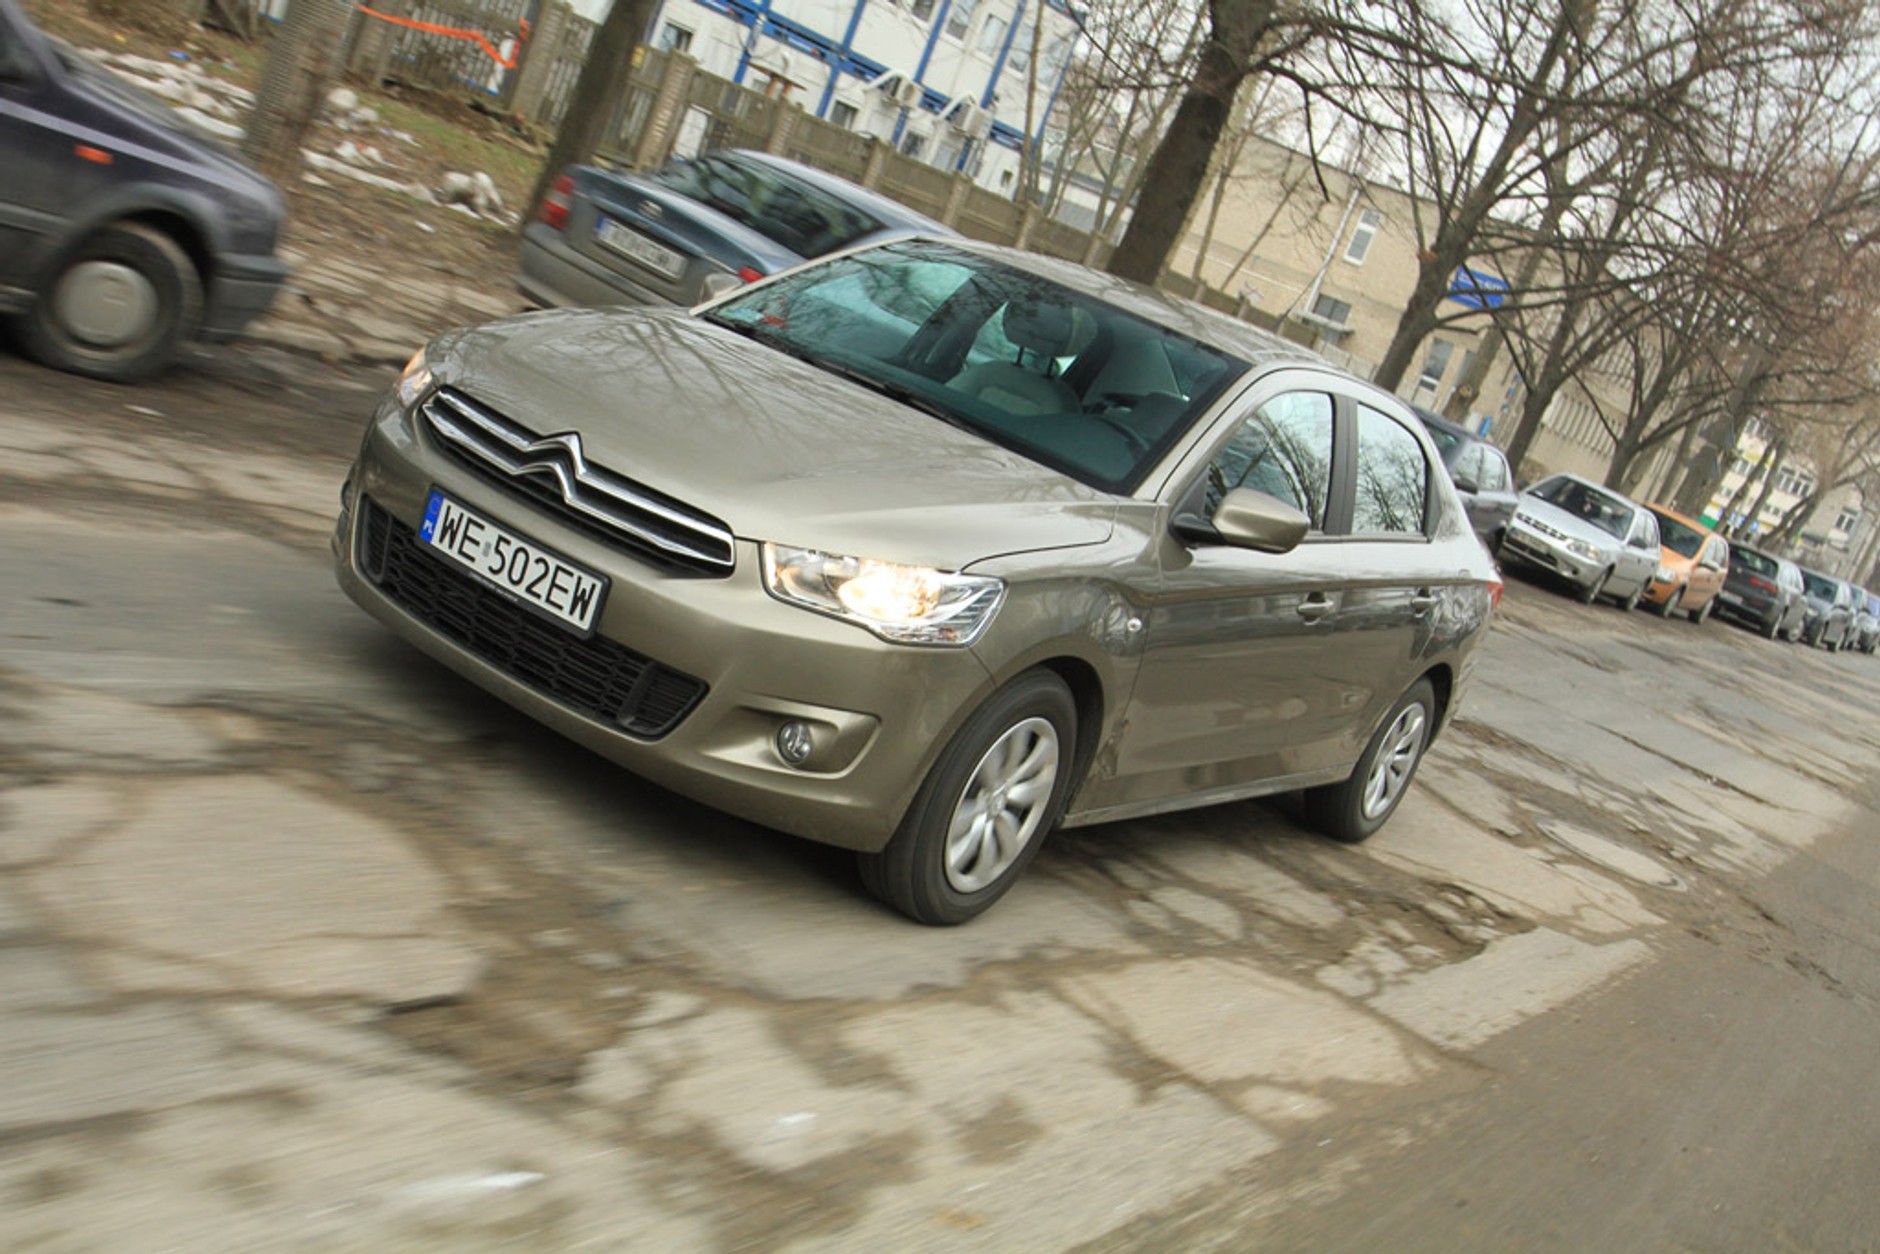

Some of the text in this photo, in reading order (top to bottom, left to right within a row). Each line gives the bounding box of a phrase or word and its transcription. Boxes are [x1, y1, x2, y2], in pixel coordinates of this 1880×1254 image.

[423, 519, 433, 534] PL
[439, 505, 485, 563] WE
[488, 534, 596, 621] 502EW
